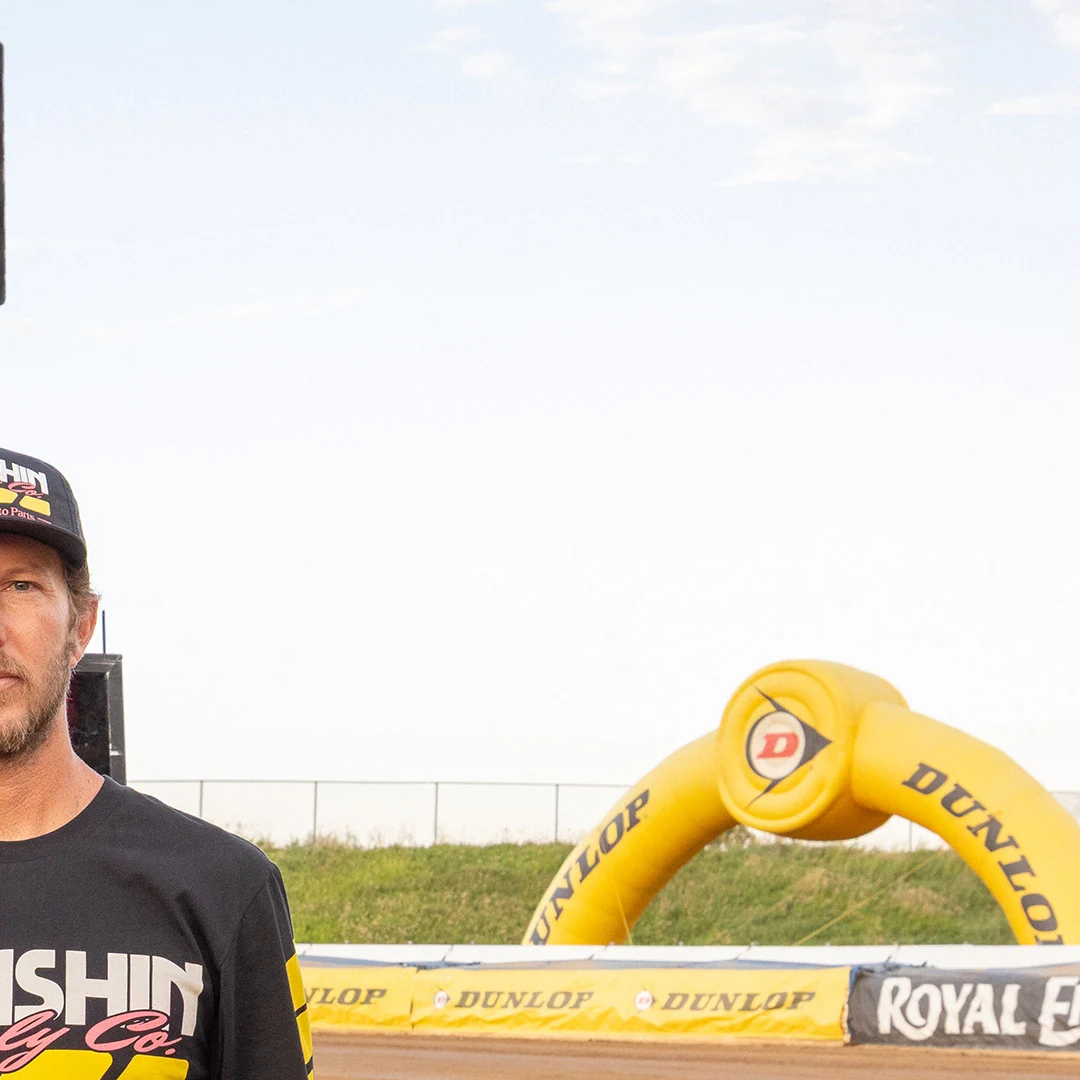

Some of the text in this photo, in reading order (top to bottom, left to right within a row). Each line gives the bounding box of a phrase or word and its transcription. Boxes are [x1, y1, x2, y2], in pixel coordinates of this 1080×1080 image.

[11, 507, 36, 521] Parts
[529, 789, 650, 945] UNLOP
[304, 987, 388, 1005] NLOP
[455, 990, 594, 1010] DUNLOP
[661, 990, 816, 1012] DUNLOP
[877, 976, 1027, 1041] ROYAL
